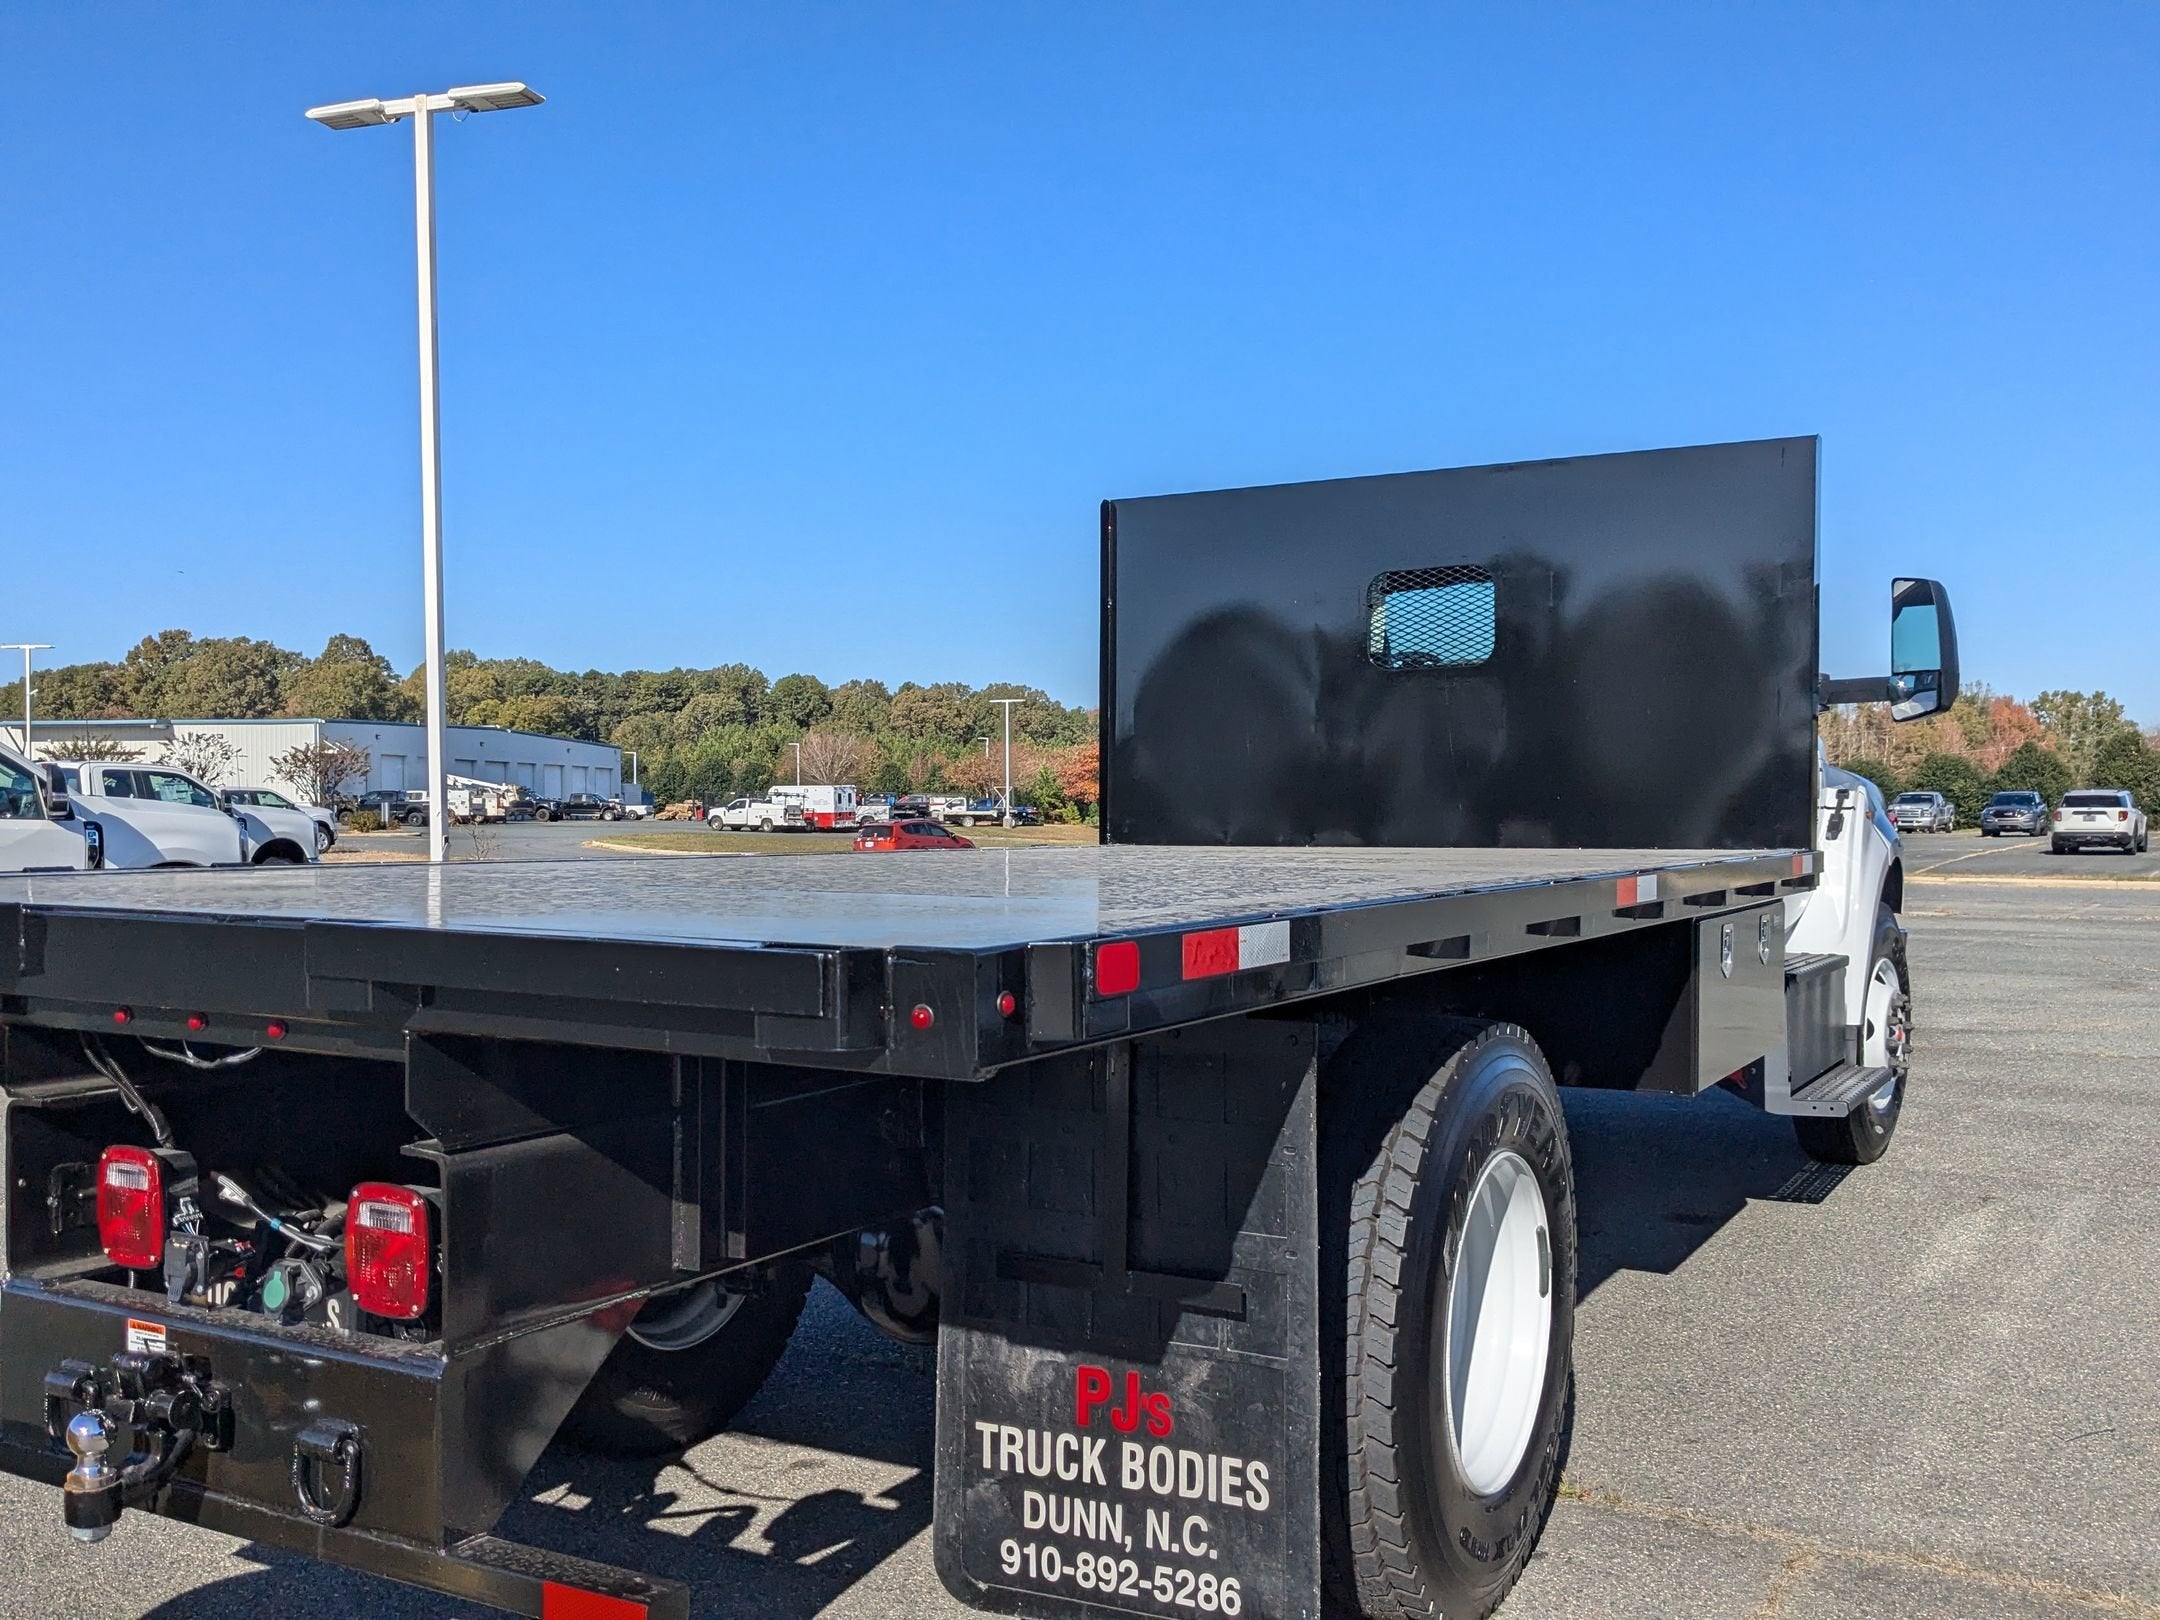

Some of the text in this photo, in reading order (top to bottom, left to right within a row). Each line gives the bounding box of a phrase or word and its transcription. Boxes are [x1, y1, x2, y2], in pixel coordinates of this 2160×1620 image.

[975, 1421, 1270, 1511] TRUCK BODIES
[1023, 1490, 1218, 1560] DUNN, N.C.
[1000, 1538, 1242, 1616] 910-892-5286
